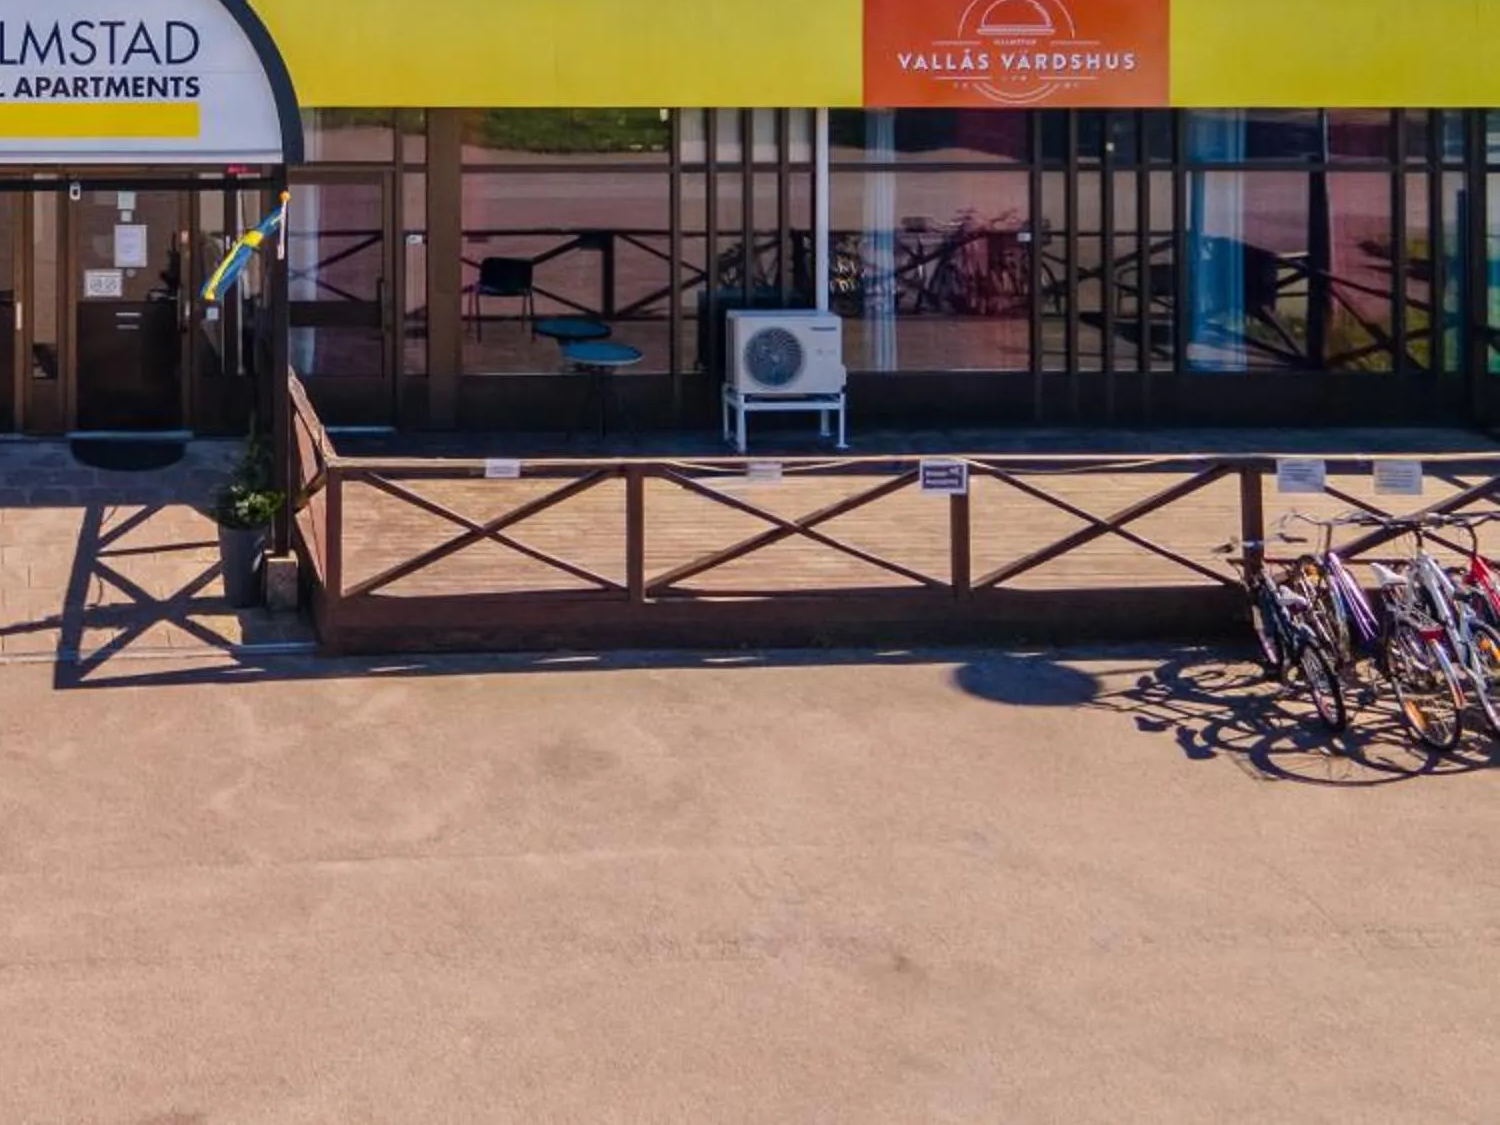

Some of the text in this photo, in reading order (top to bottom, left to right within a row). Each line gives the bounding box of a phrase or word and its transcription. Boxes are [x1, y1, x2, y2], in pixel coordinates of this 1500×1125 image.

[897, 48, 1136, 70] VALLÅS VÄRDSHUS
[13, 75, 201, 98] APARTMENTS
